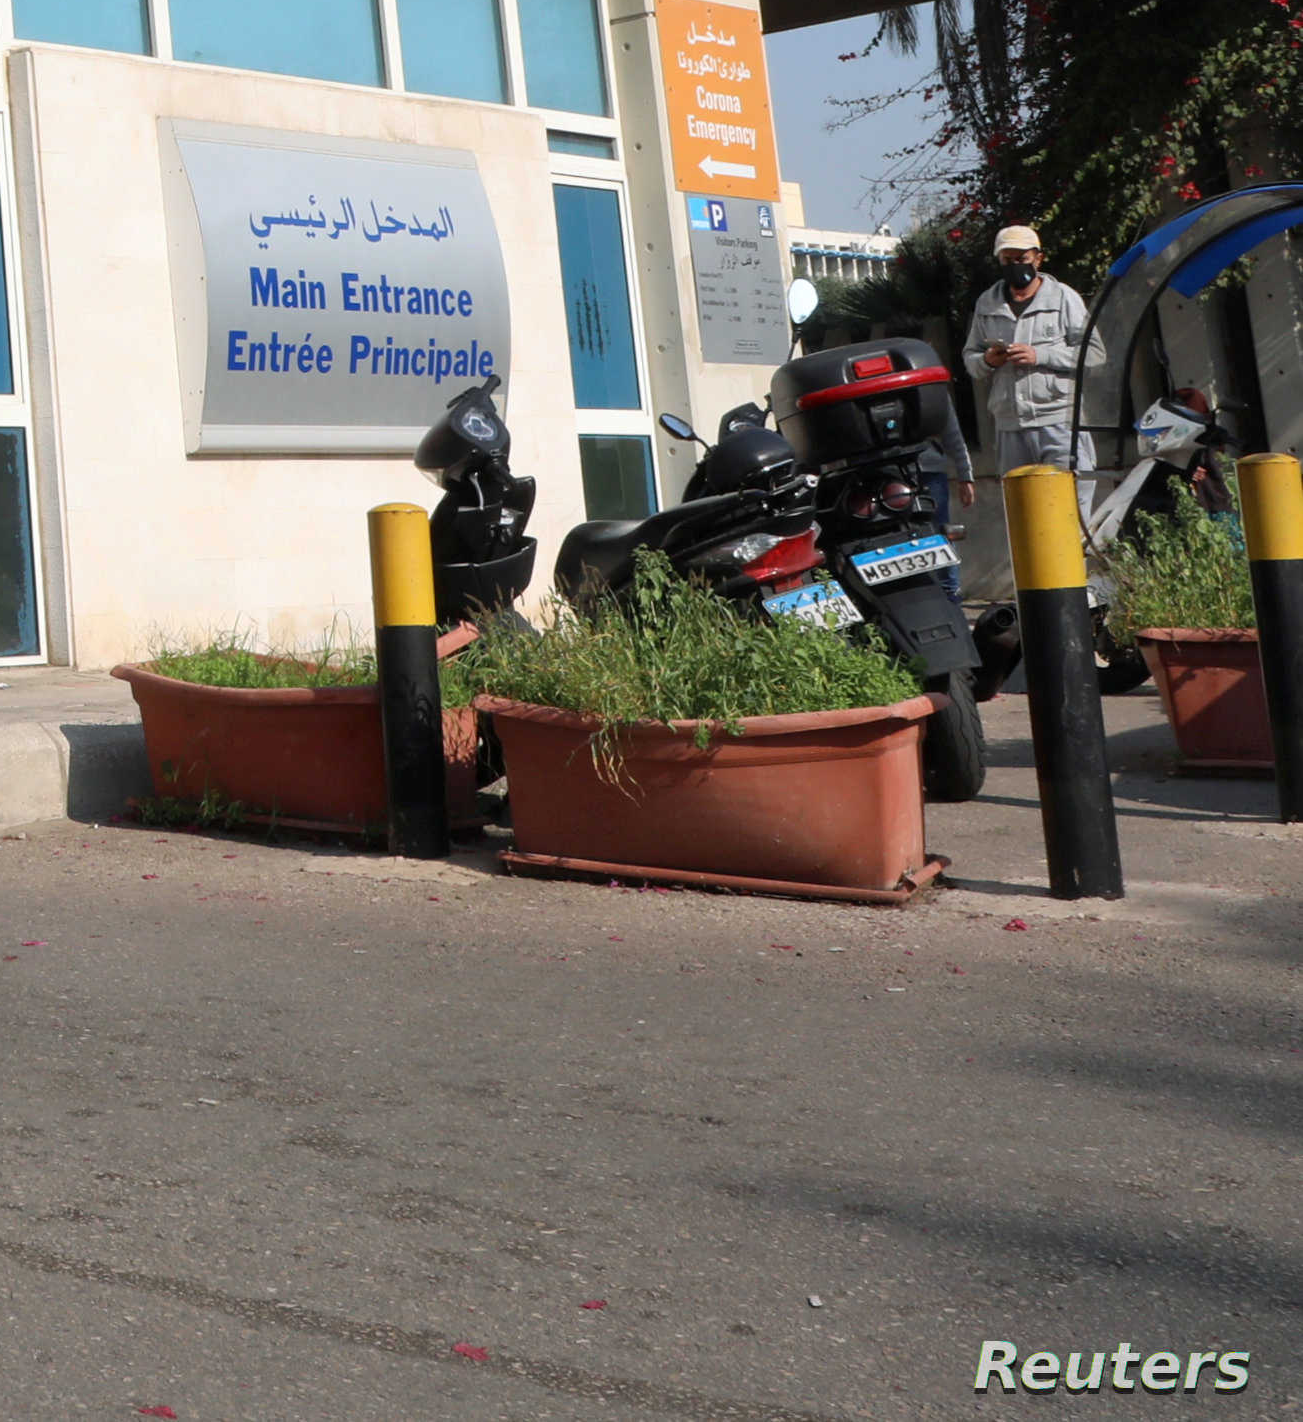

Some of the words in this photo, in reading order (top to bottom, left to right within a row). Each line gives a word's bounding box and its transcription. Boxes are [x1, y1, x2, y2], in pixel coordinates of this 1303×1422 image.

[686, 21, 736, 47] مدخل
[695, 85, 742, 114] Corona
[686, 113, 756, 151] Emergency
[249, 194, 356, 251] الرئيسي
[362, 198, 455, 243] المدخل
[711, 203, 724, 228] P
[249, 266, 327, 310] Main
[341, 272, 474, 317] Entrance
[227, 330, 333, 374] Entrée
[349, 335, 494, 384] Principale
[861, 548, 953, 582] M813371
